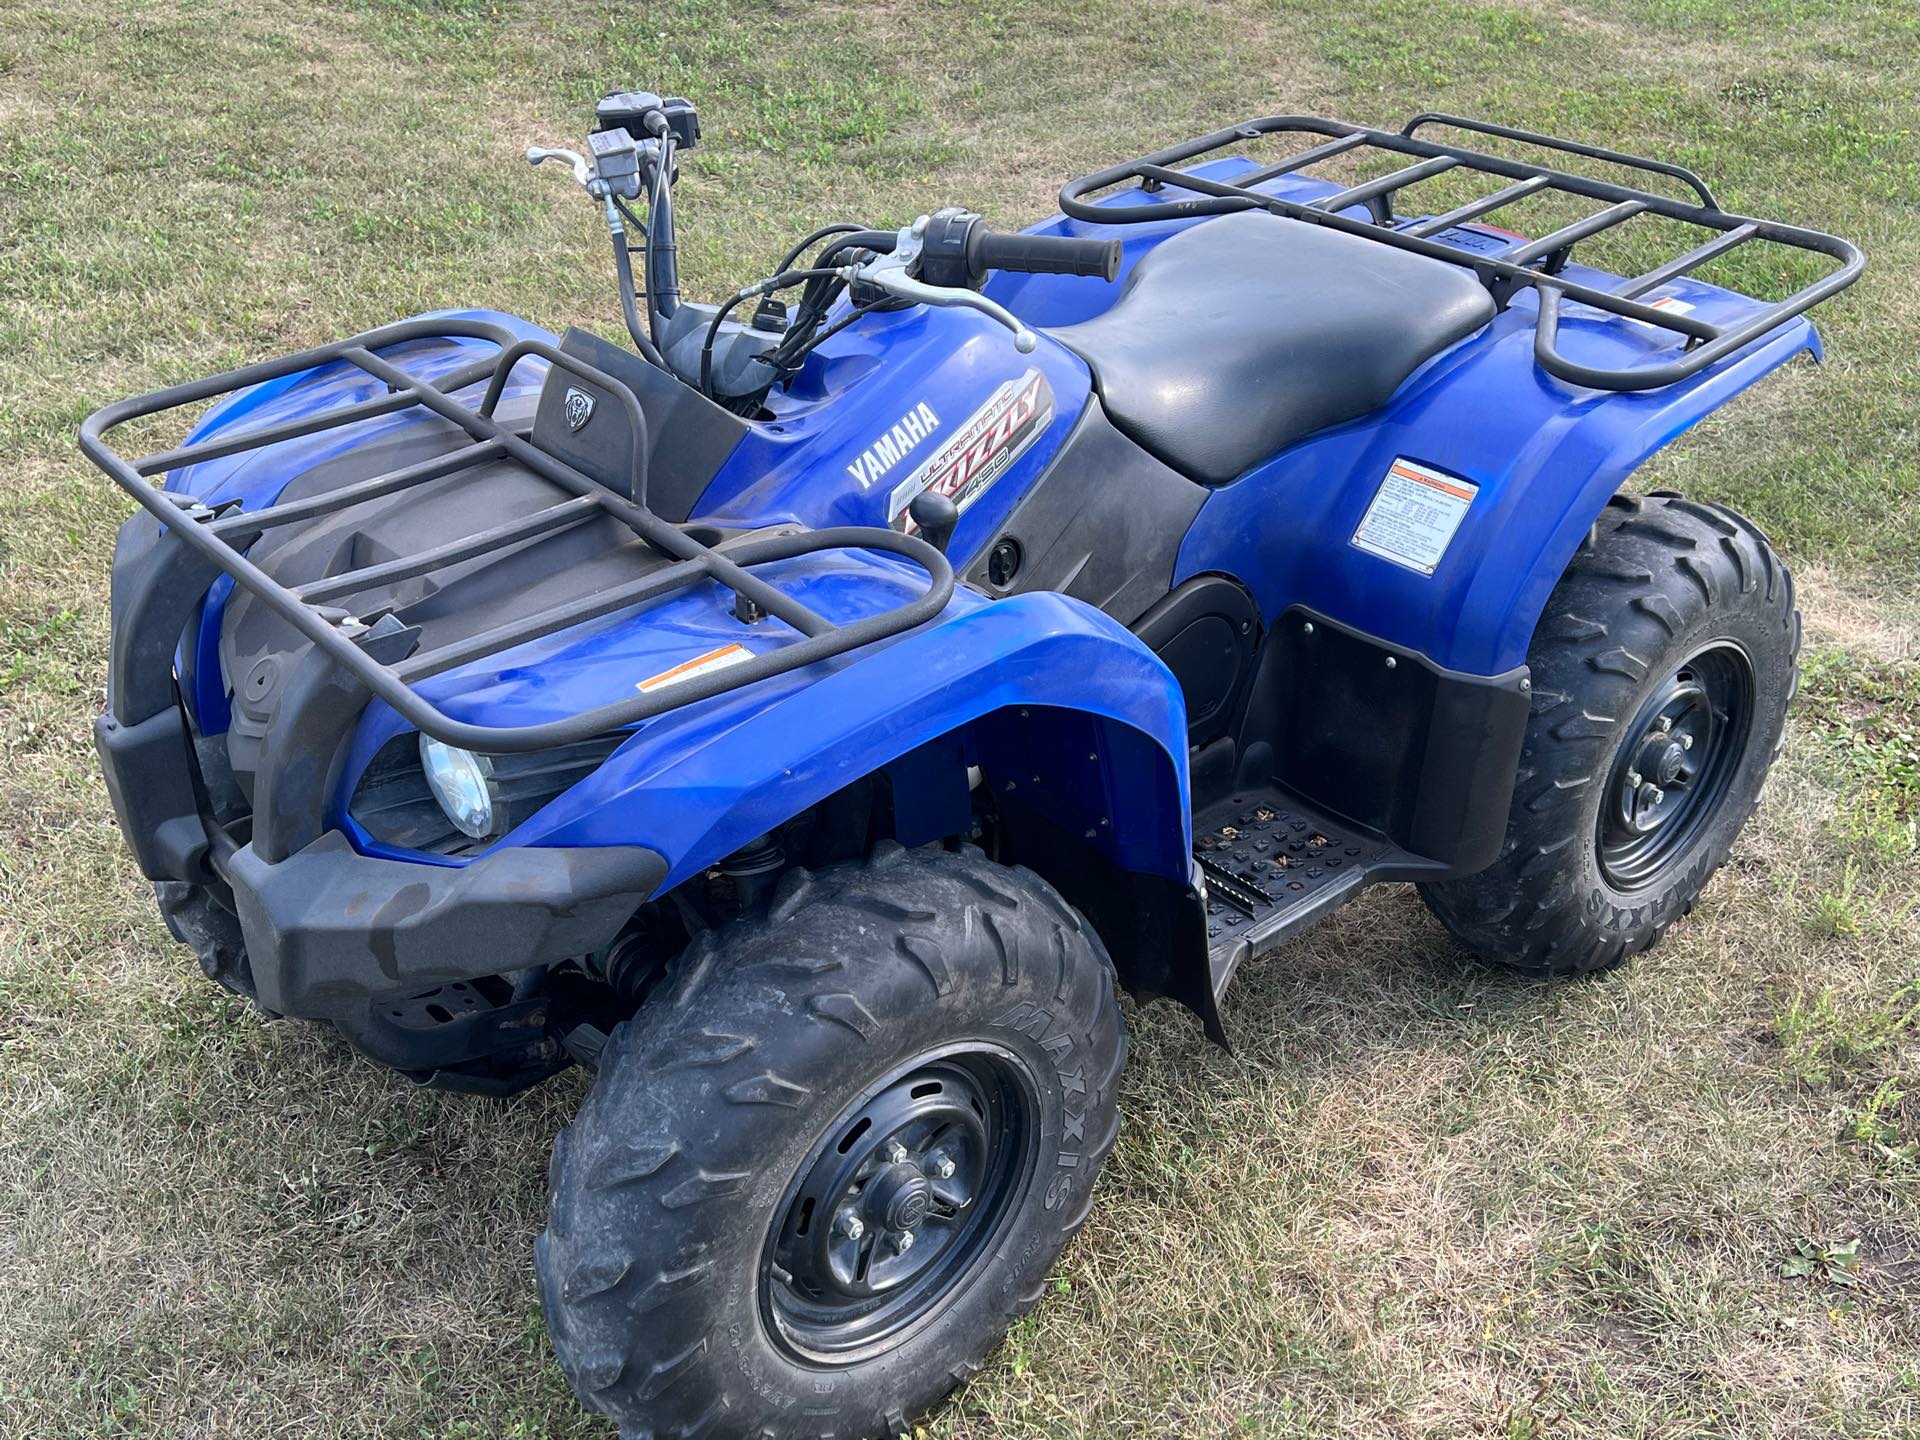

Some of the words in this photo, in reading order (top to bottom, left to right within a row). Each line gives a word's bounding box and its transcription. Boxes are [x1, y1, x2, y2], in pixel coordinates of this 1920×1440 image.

[847, 402, 940, 489] YAMAHA
[920, 386, 1015, 484] ULTRAMATIC
[965, 447, 1010, 497] 450
[1586, 844, 1711, 931] MAXXIS
[990, 1001, 1087, 1212] MAXXIS
